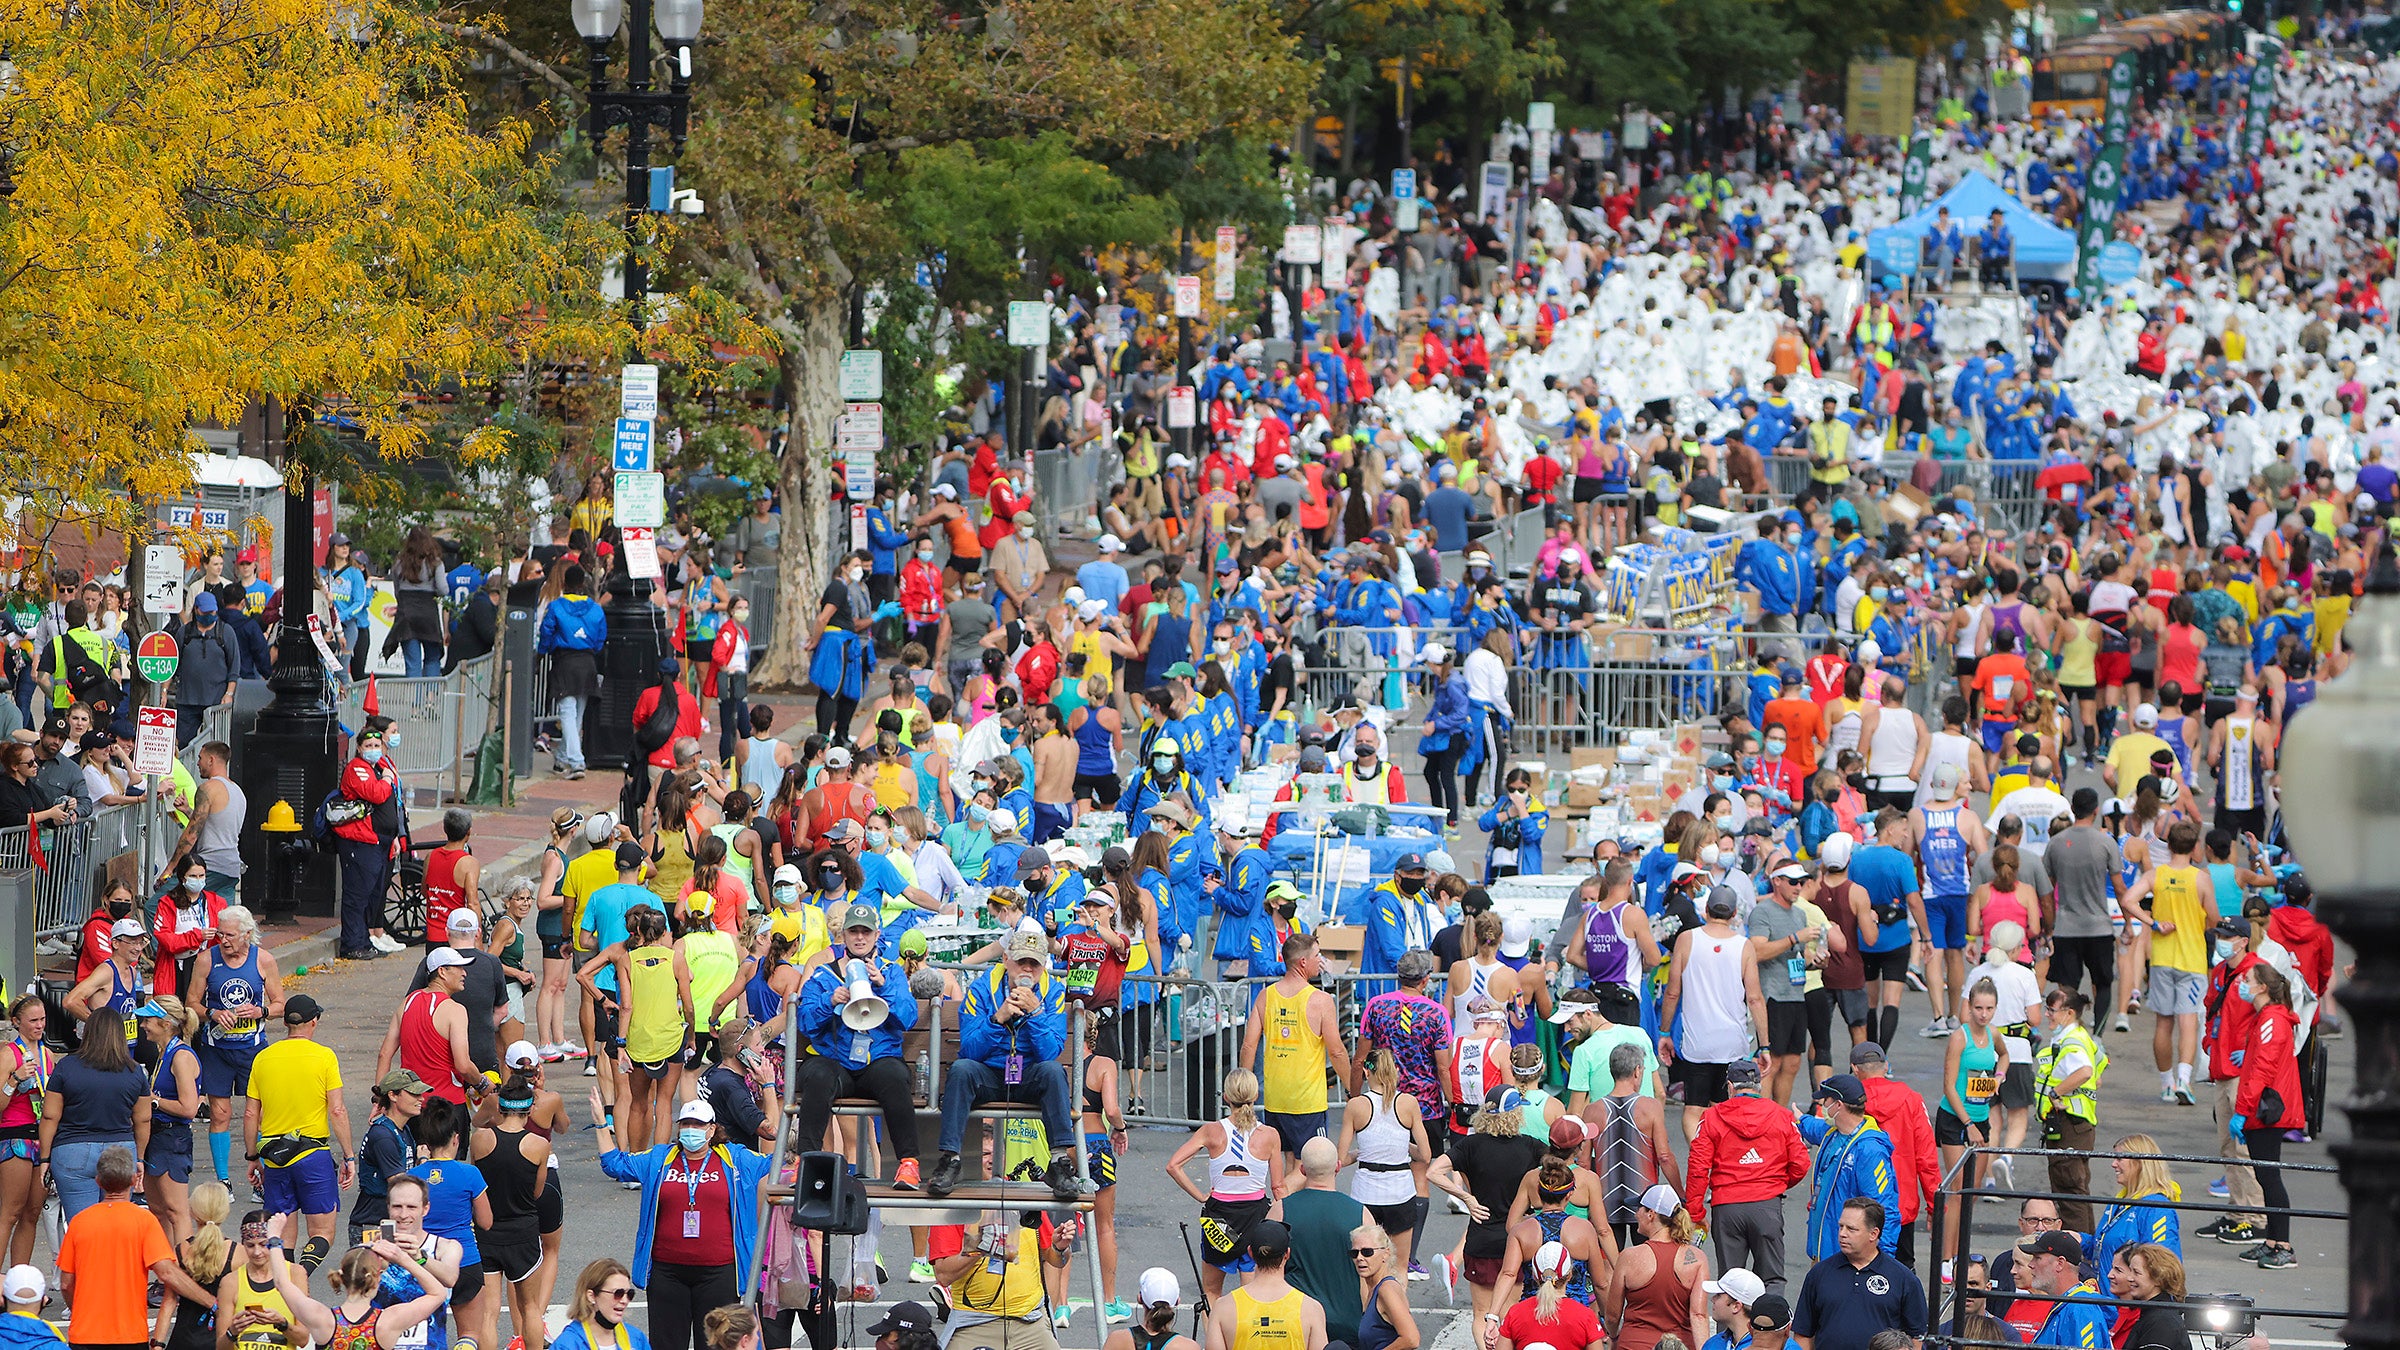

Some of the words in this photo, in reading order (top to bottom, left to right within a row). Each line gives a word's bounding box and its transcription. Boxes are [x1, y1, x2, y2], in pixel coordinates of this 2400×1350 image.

[625, 421, 641, 431] PAY
[619, 431, 647, 441] METER
[621, 441, 643, 451] HERE
[617, 475, 628, 487] 2
[153, 635, 167, 656] F
[141, 659, 173, 675] G-13A
[152, 728, 164, 736] NO
[1927, 811, 1955, 829] ADAM
[1587, 933, 1618, 944] BOSTON
[1592, 943, 1611, 953] 2021
[1738, 1157, 1764, 1165] adidas
[664, 1168, 720, 1184] Bates
